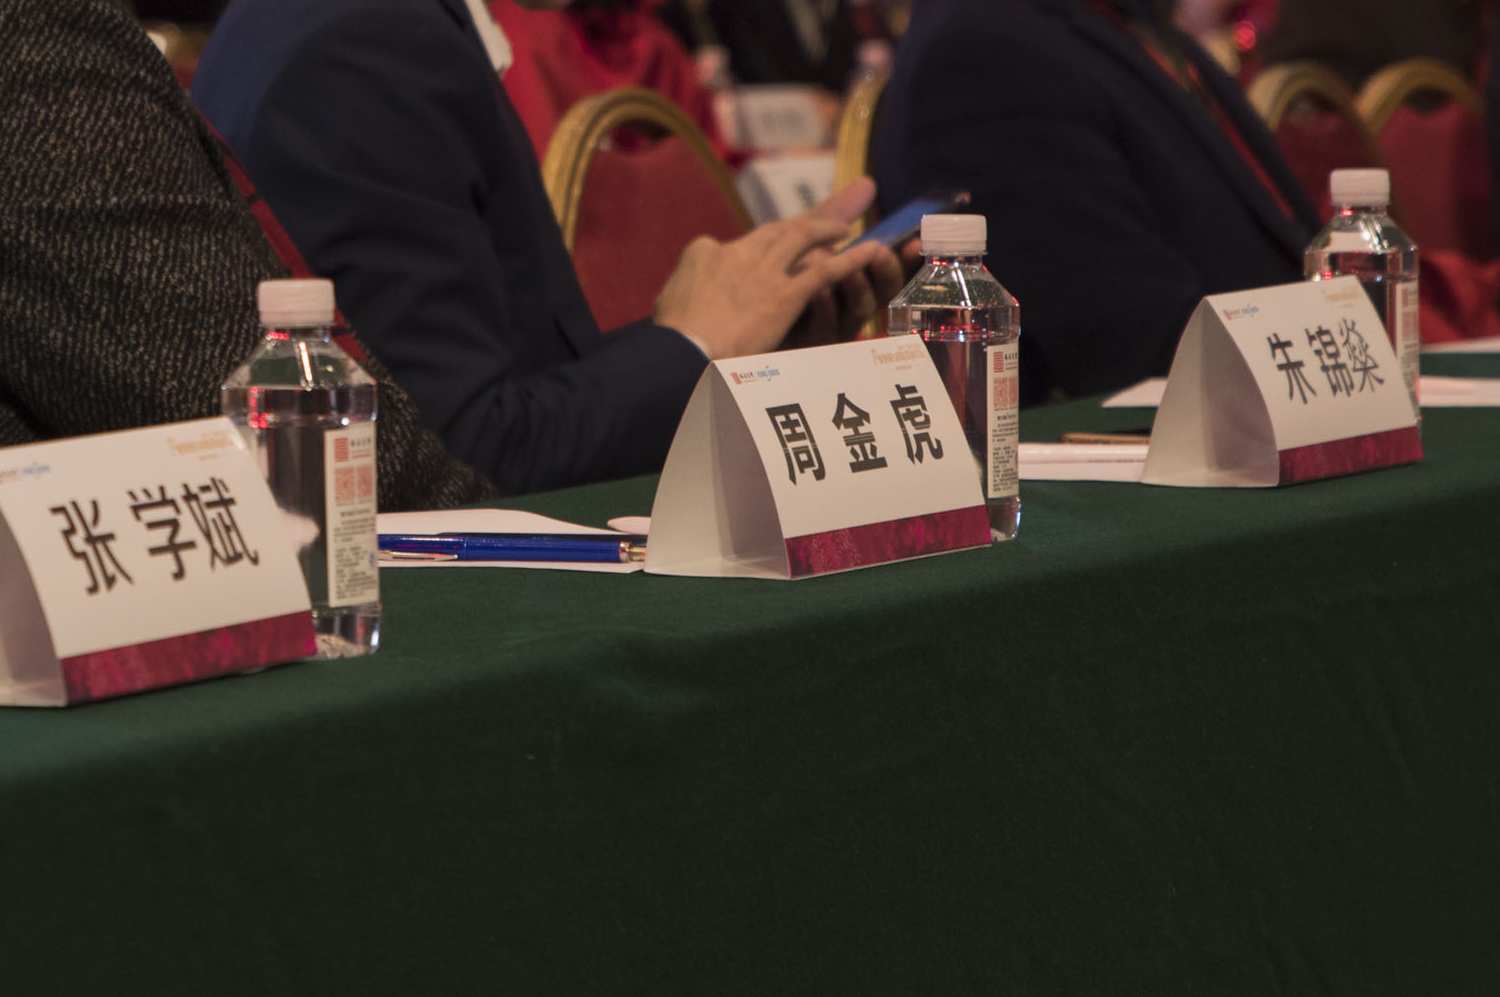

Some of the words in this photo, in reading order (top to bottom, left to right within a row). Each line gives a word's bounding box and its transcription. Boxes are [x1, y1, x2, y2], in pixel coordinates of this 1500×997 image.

[766, 383, 944, 486] 周金虎
[49, 476, 260, 595] 张学斌
